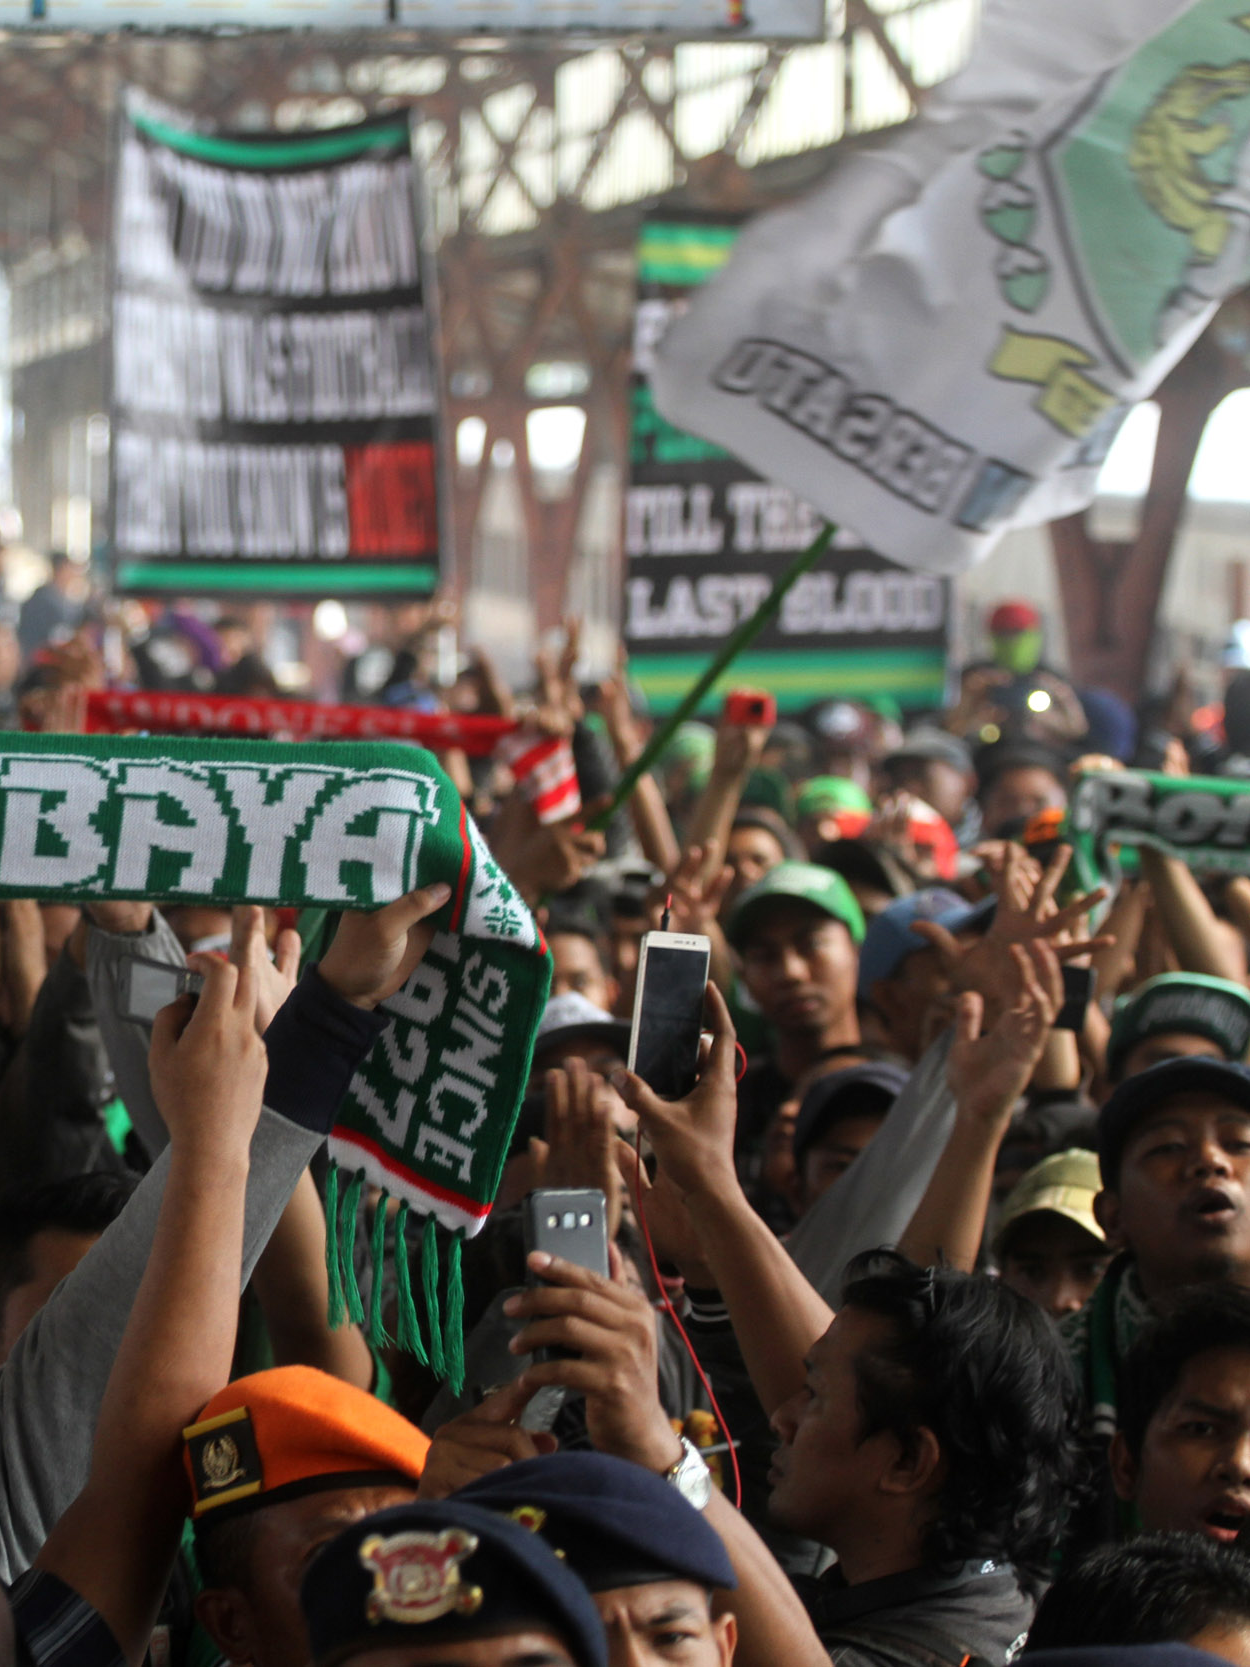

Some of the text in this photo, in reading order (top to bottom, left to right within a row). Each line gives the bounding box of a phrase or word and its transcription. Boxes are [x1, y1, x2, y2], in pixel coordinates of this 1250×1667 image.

[727, 482, 861, 551] TH
[626, 571, 943, 639] LAST BLOOD
[413, 951, 510, 1184] SINCE
